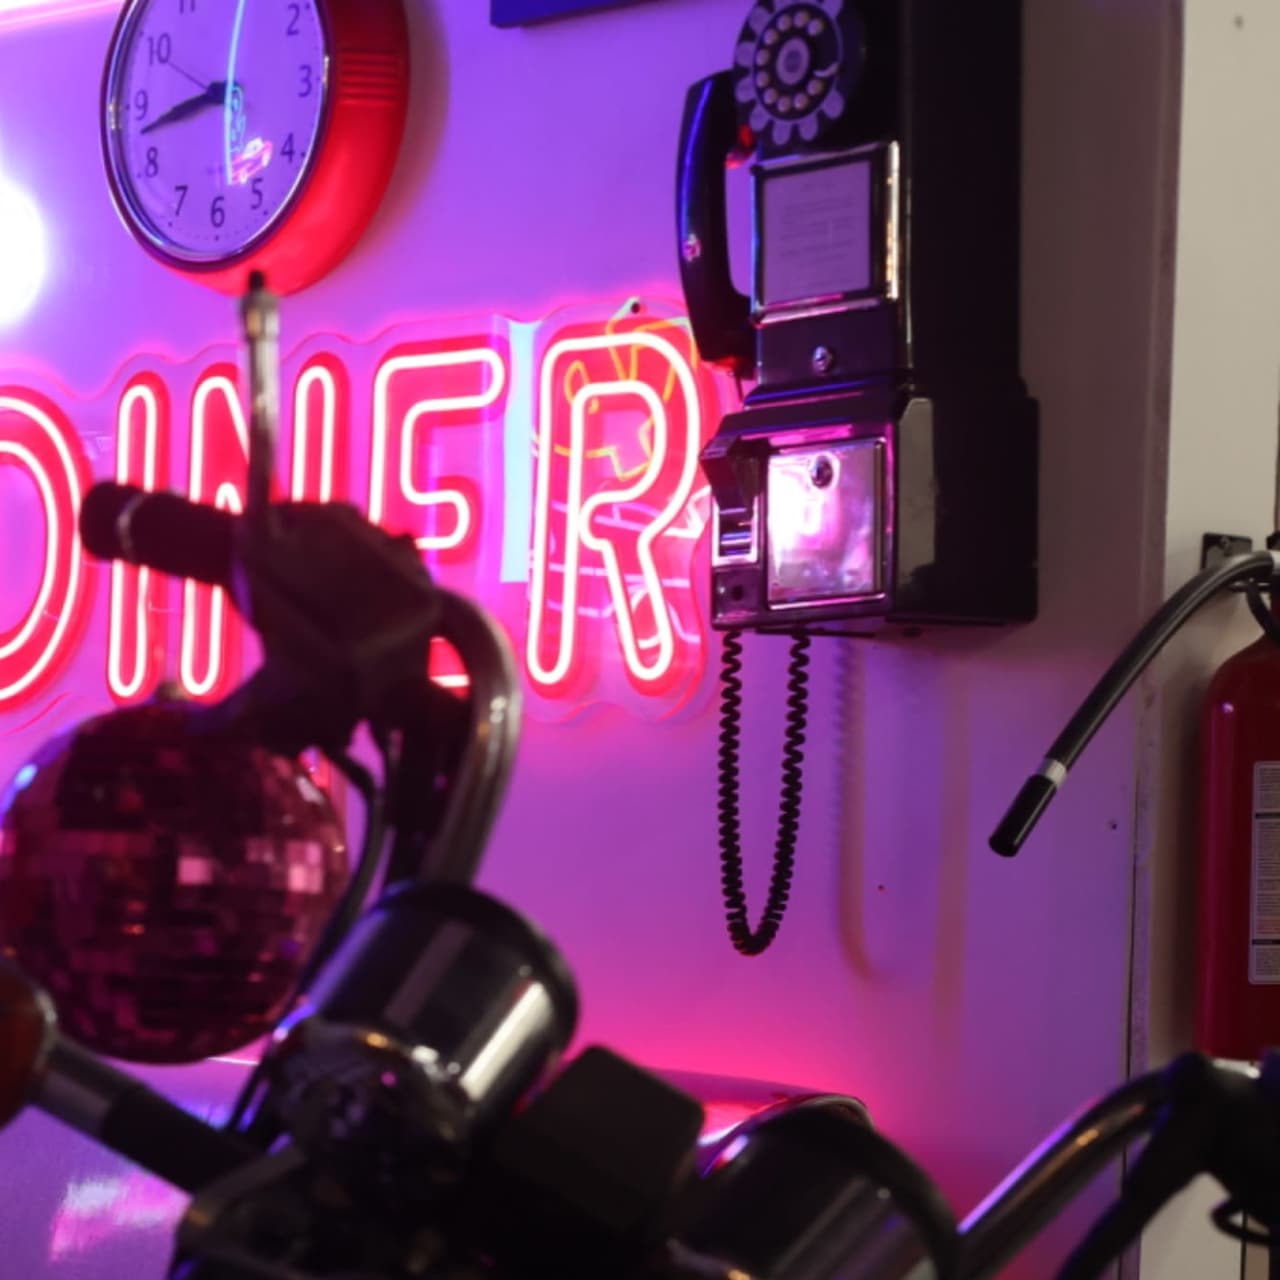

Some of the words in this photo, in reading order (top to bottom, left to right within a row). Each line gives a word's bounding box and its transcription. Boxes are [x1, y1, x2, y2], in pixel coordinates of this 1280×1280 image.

[285, 3, 301, 37] 2
[146, 32, 172, 67] 10
[297, 64, 313, 98] 3
[133, 90, 149, 122] 9
[144, 146, 160, 178] 8
[279, 132, 296, 164] 4
[173, 184, 189, 217] 7
[250, 176, 264, 210] 5
[209, 195, 226, 228] 6
